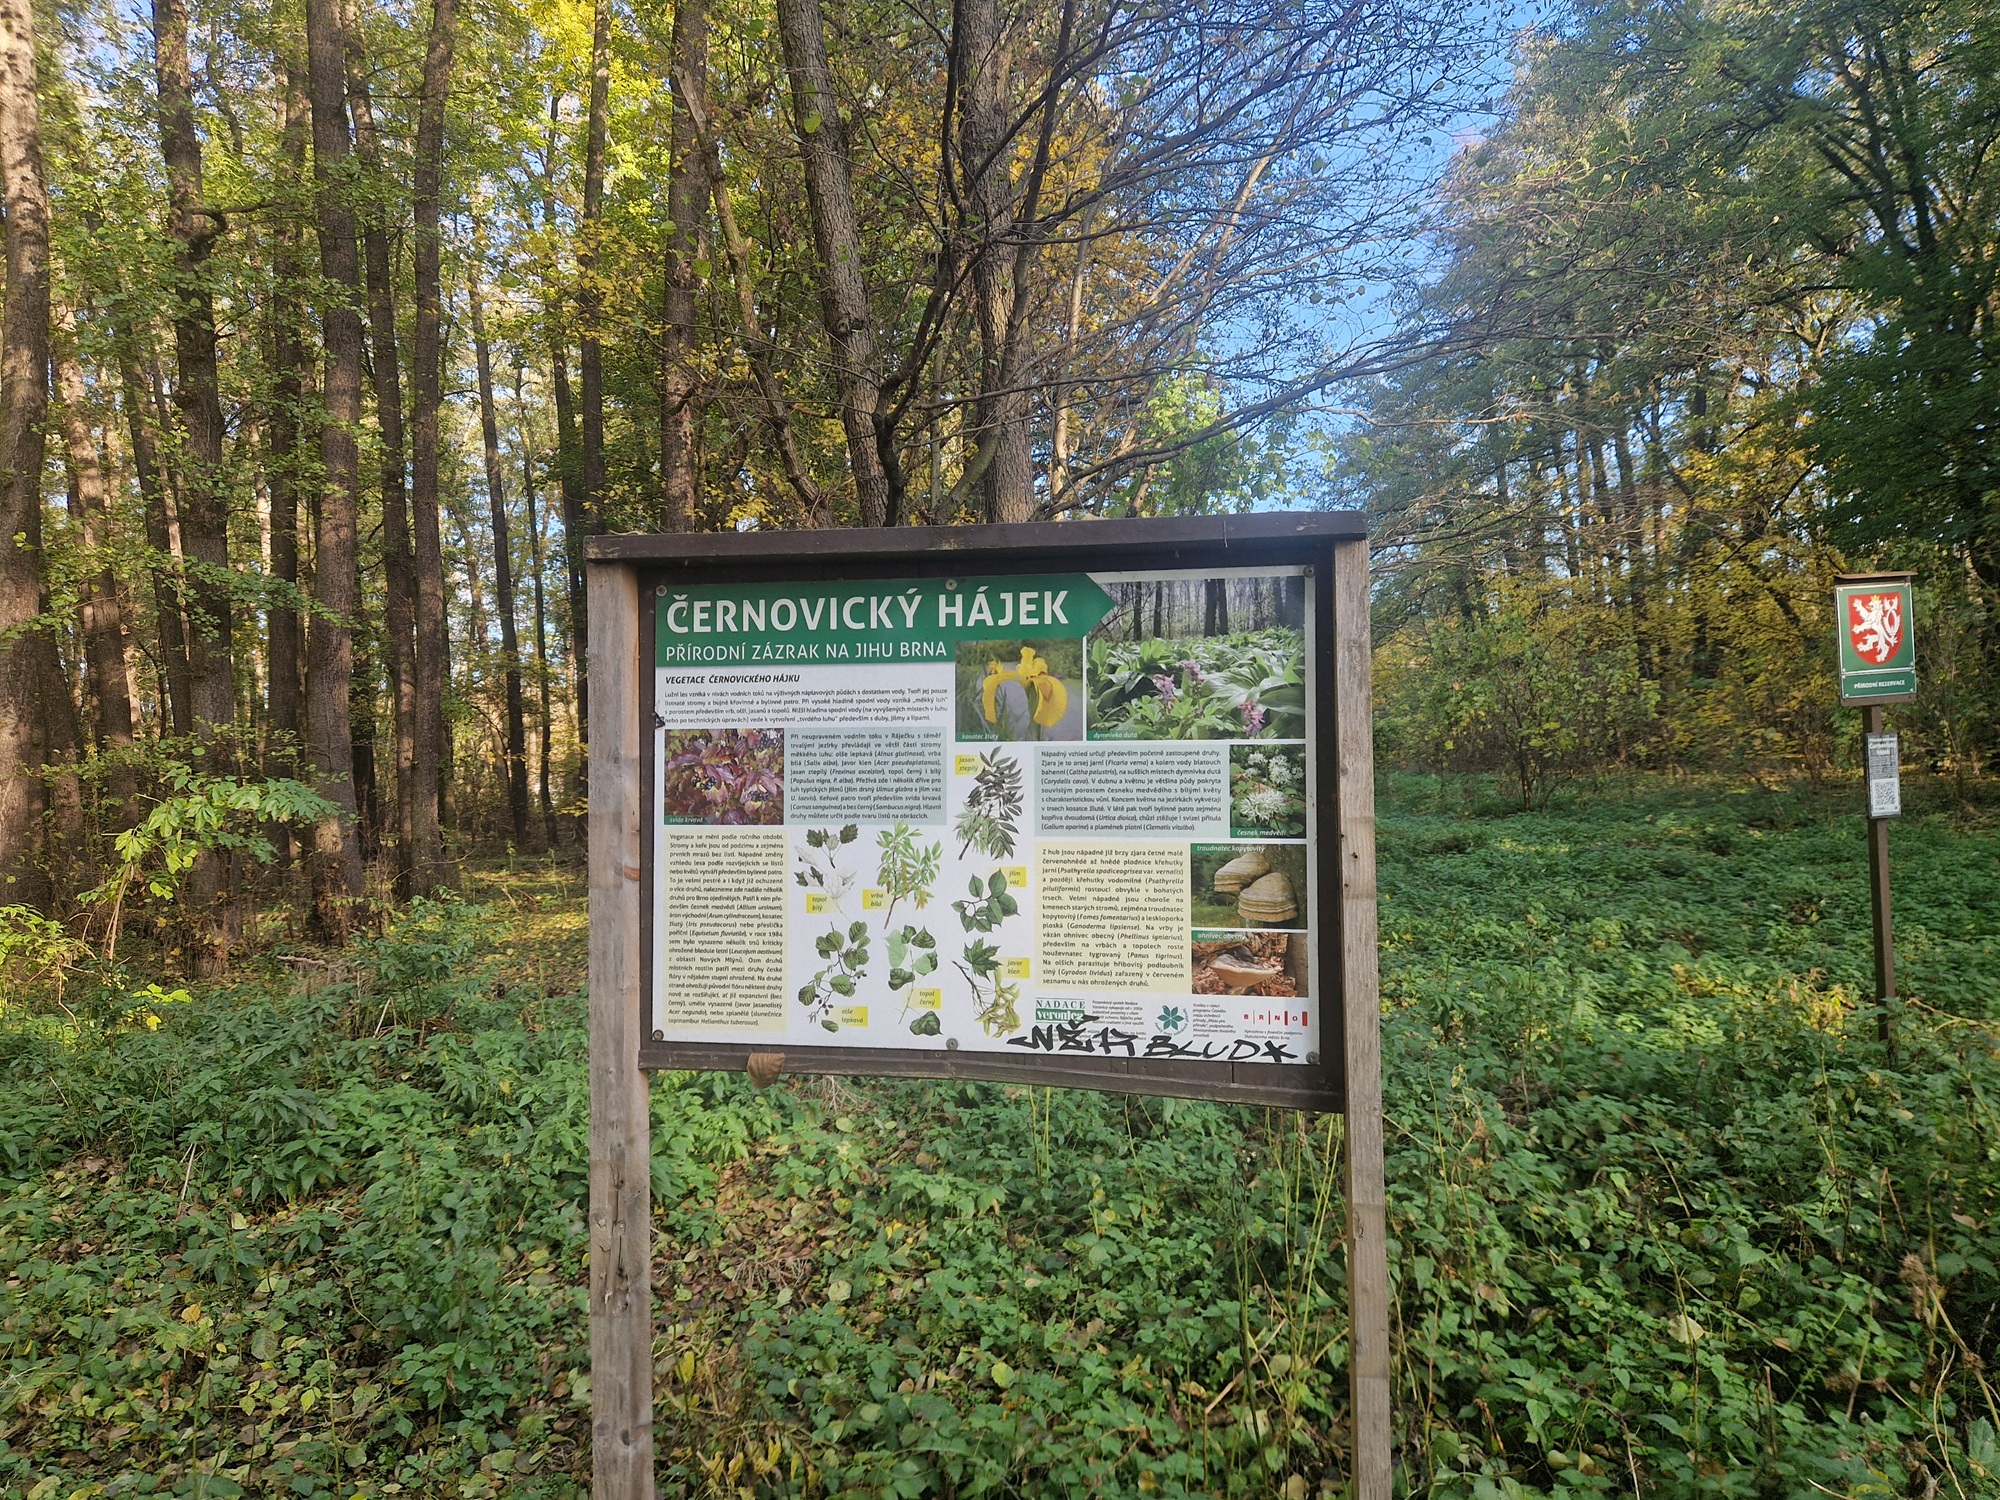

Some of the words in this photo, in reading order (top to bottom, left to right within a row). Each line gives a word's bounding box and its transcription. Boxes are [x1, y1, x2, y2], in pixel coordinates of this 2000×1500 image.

[666, 588, 922, 633] ČERNOVICKÝ
[938, 586, 1069, 628] HÁJEK
[666, 644, 745, 661] PŘÍRODNÍ
[752, 642, 819, 660] ZÁZRAK
[826, 645, 849, 659] NA
[855, 643, 893, 658] JIHU
[900, 642, 947, 657] BRNA
[665, 676, 705, 684] VEGETACE
[708, 674, 771, 684] ČERNOVICKÉHO
[773, 673, 800, 682] HÁJKU
[1036, 1000, 1086, 1009] NADACE
